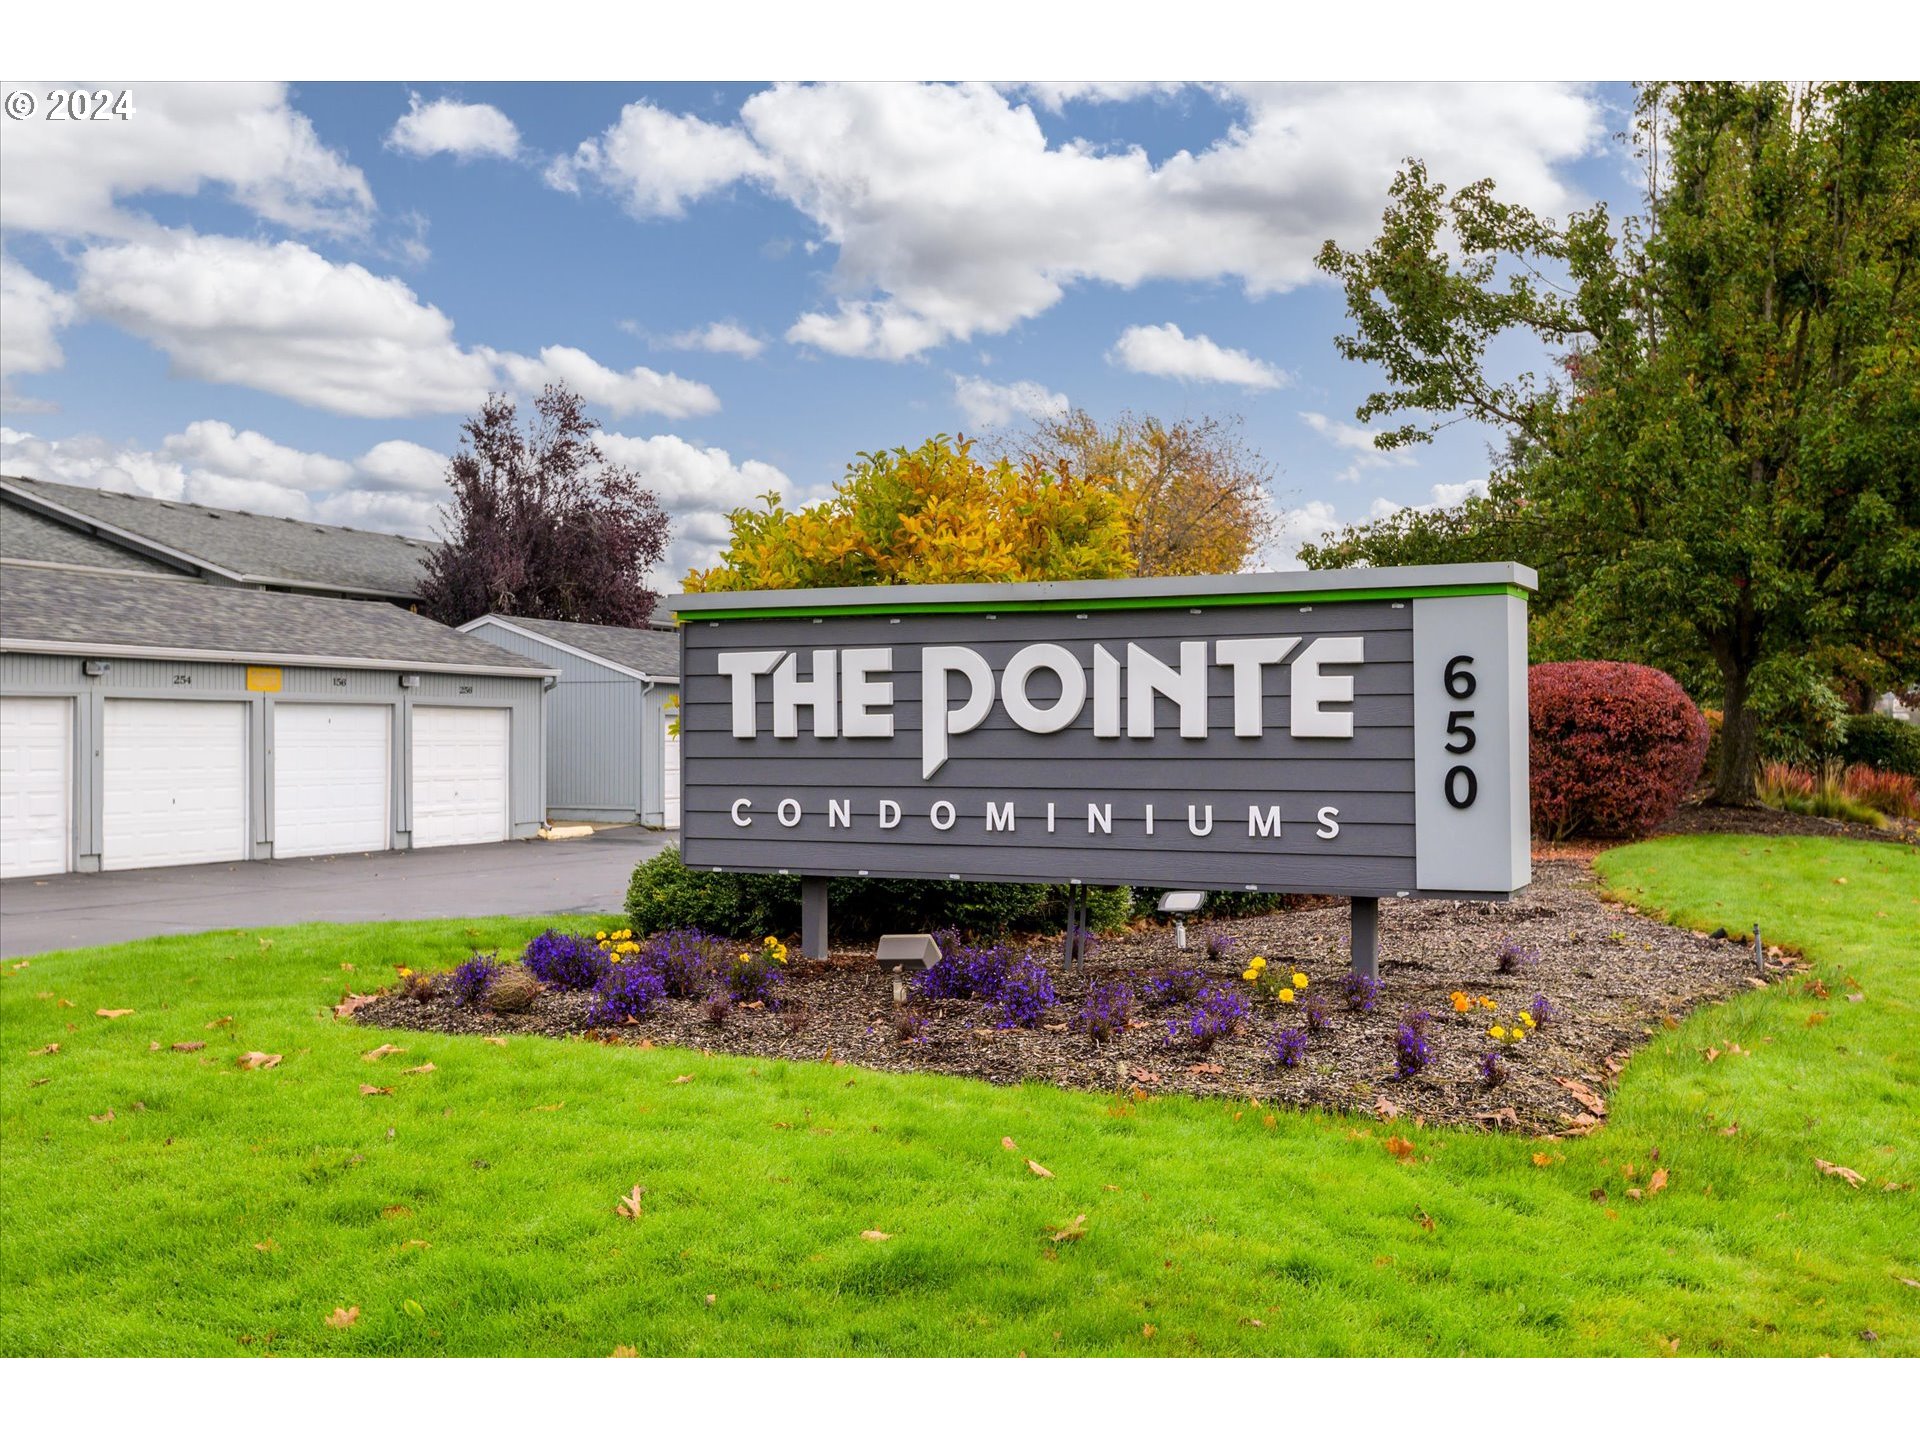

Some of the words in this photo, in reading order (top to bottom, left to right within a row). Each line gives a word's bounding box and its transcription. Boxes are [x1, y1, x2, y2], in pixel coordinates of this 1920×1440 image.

[173, 675, 192, 685] 254
[718, 647, 896, 739] THE
[922, 636, 1365, 780] POINTE
[1443, 655, 1478, 810] 650
[731, 797, 1342, 840] CONDOMINIUMS
